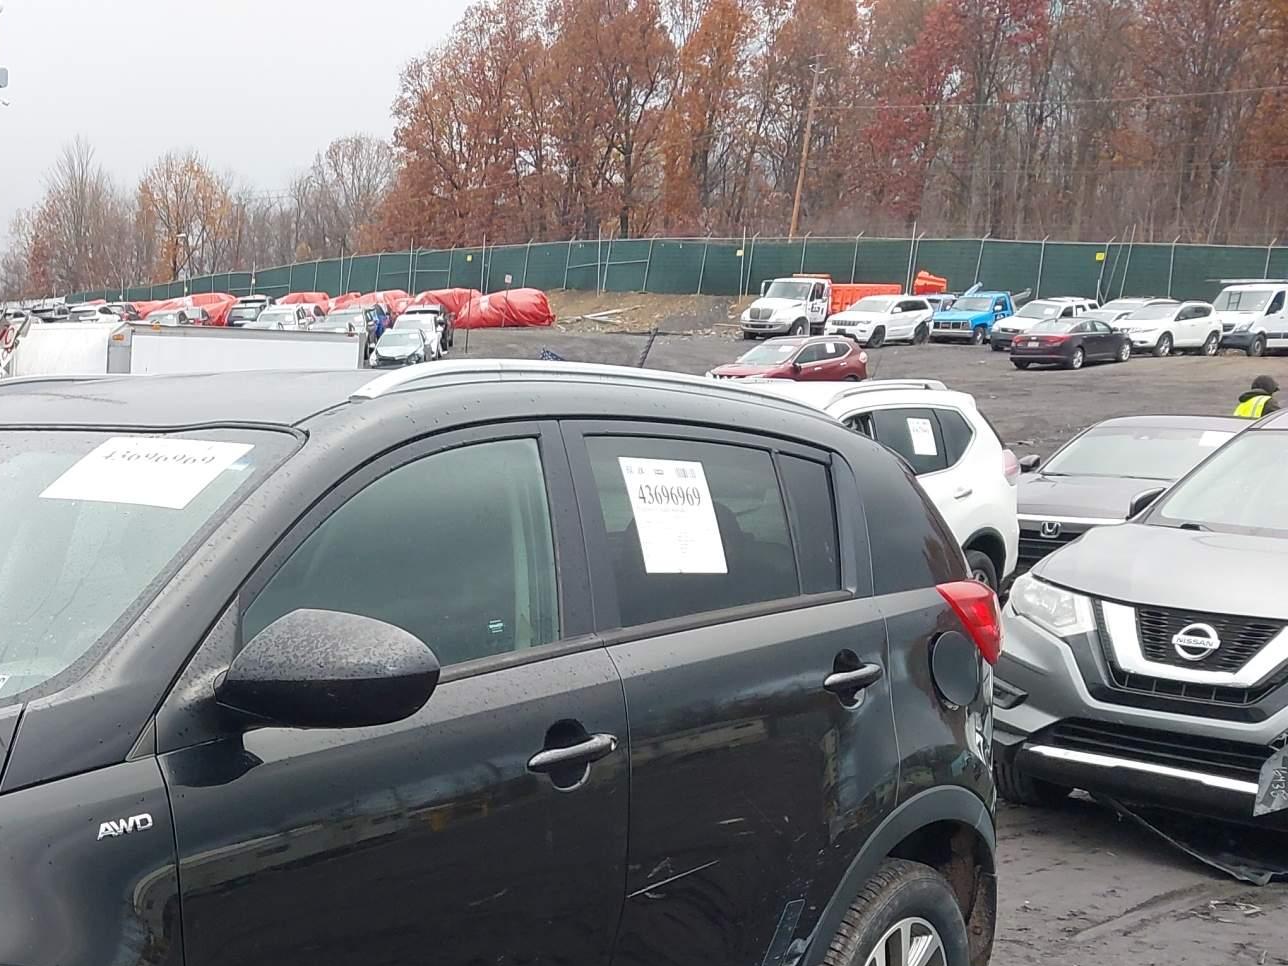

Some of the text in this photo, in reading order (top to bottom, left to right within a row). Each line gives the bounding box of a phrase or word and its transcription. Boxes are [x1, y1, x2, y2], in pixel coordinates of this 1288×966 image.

[638, 484, 701, 506] 43696969
[1176, 637, 1214, 647] NISSAN
[96, 813, 153, 841] AWD
